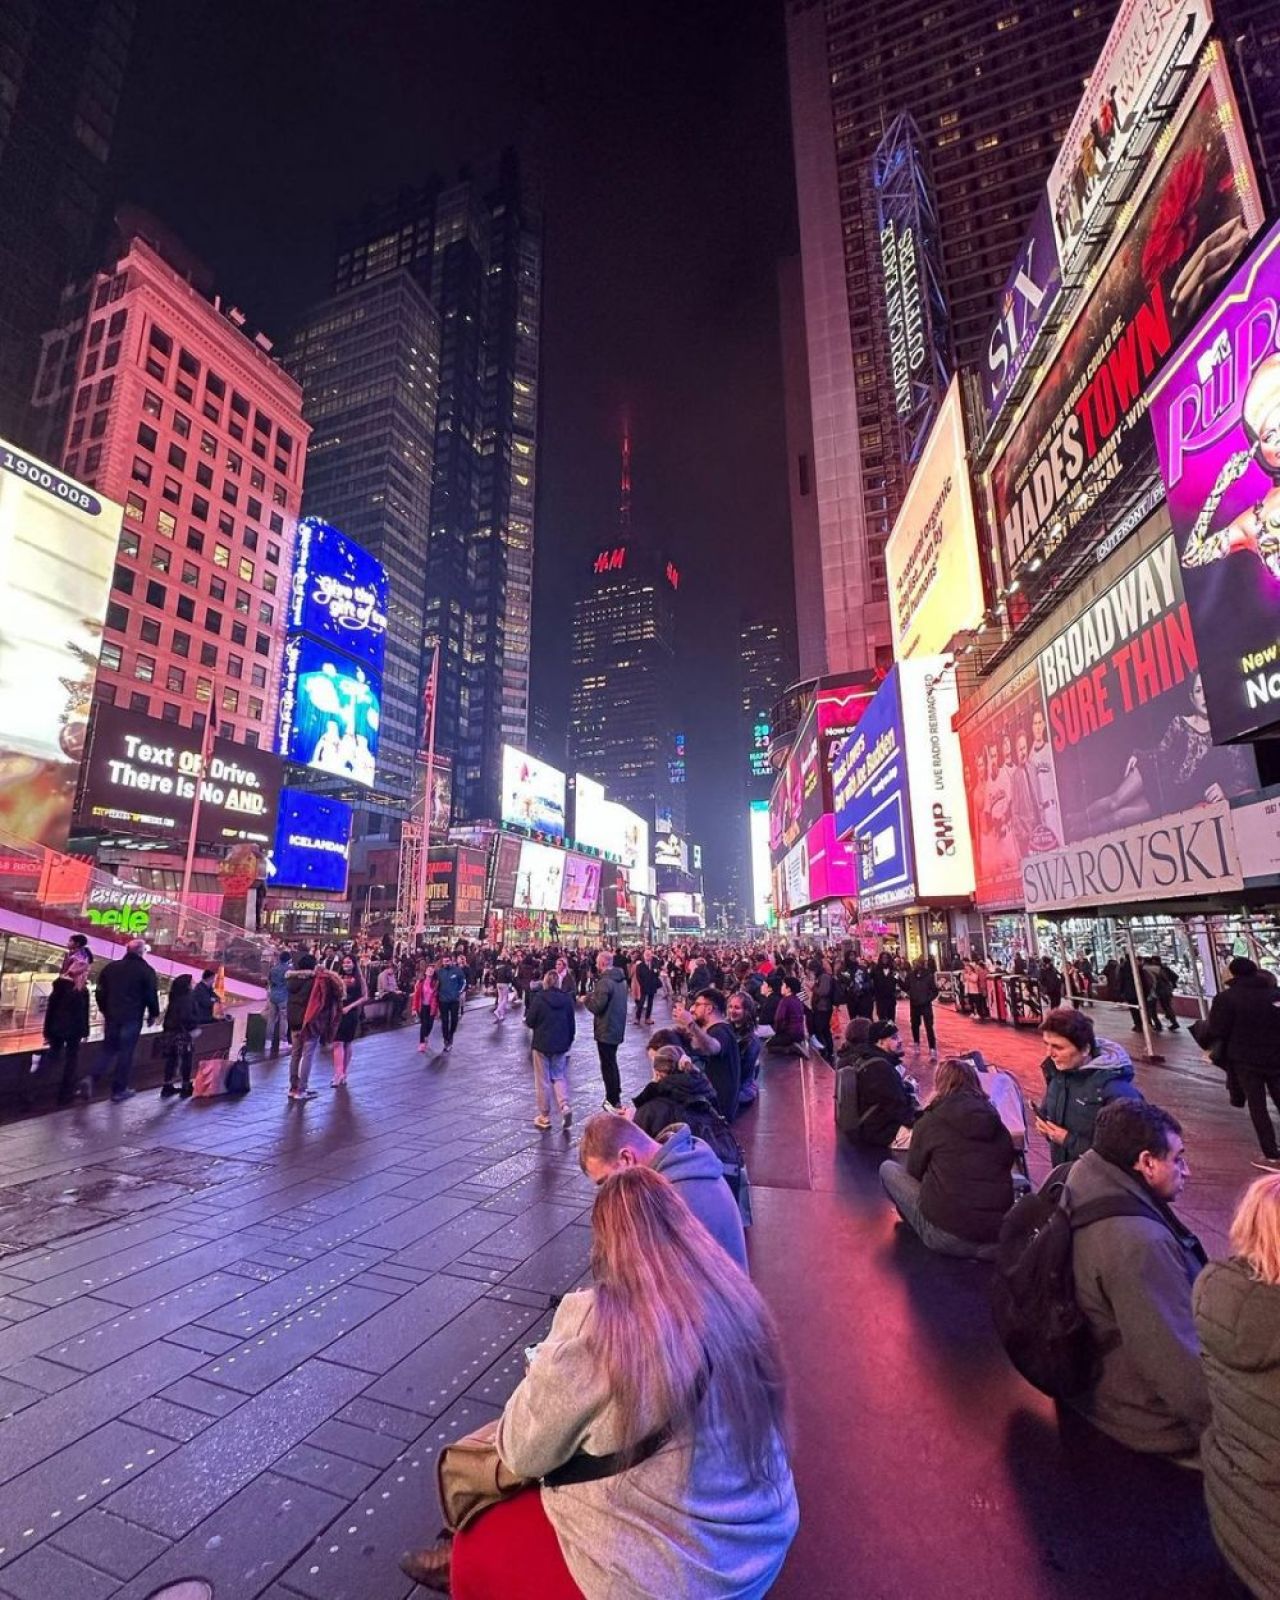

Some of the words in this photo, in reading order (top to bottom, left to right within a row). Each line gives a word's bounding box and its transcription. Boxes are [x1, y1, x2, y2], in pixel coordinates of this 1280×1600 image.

[897, 227, 925, 370] OUTFITTERS
[988, 237, 1047, 401] SIX
[886, 289, 911, 414] AMERICAN
[1085, 341, 1112, 384] COULD
[1005, 281, 1172, 566] HADESTOWN
[4, 453, 90, 509] 1900.008
[1096, 500, 1149, 562] OUTFRONT
[1041, 534, 1175, 697] BROADWAY
[1241, 644, 1278, 674] New
[924, 673, 941, 736] REIMAGED
[1050, 662, 1114, 752] SURE
[124, 734, 175, 768] Text
[210, 758, 261, 788] Drive.
[755, 735, 770, 748] 23
[929, 735, 943, 769] RADIO
[108, 759, 173, 795] There
[175, 776, 196, 800] Is
[199, 781, 224, 805] No
[225, 788, 268, 816] AND.
[935, 768, 945, 792] LIVE
[1023, 814, 1234, 904] SWAROVSKI
[293, 901, 326, 910] EXPRESS
